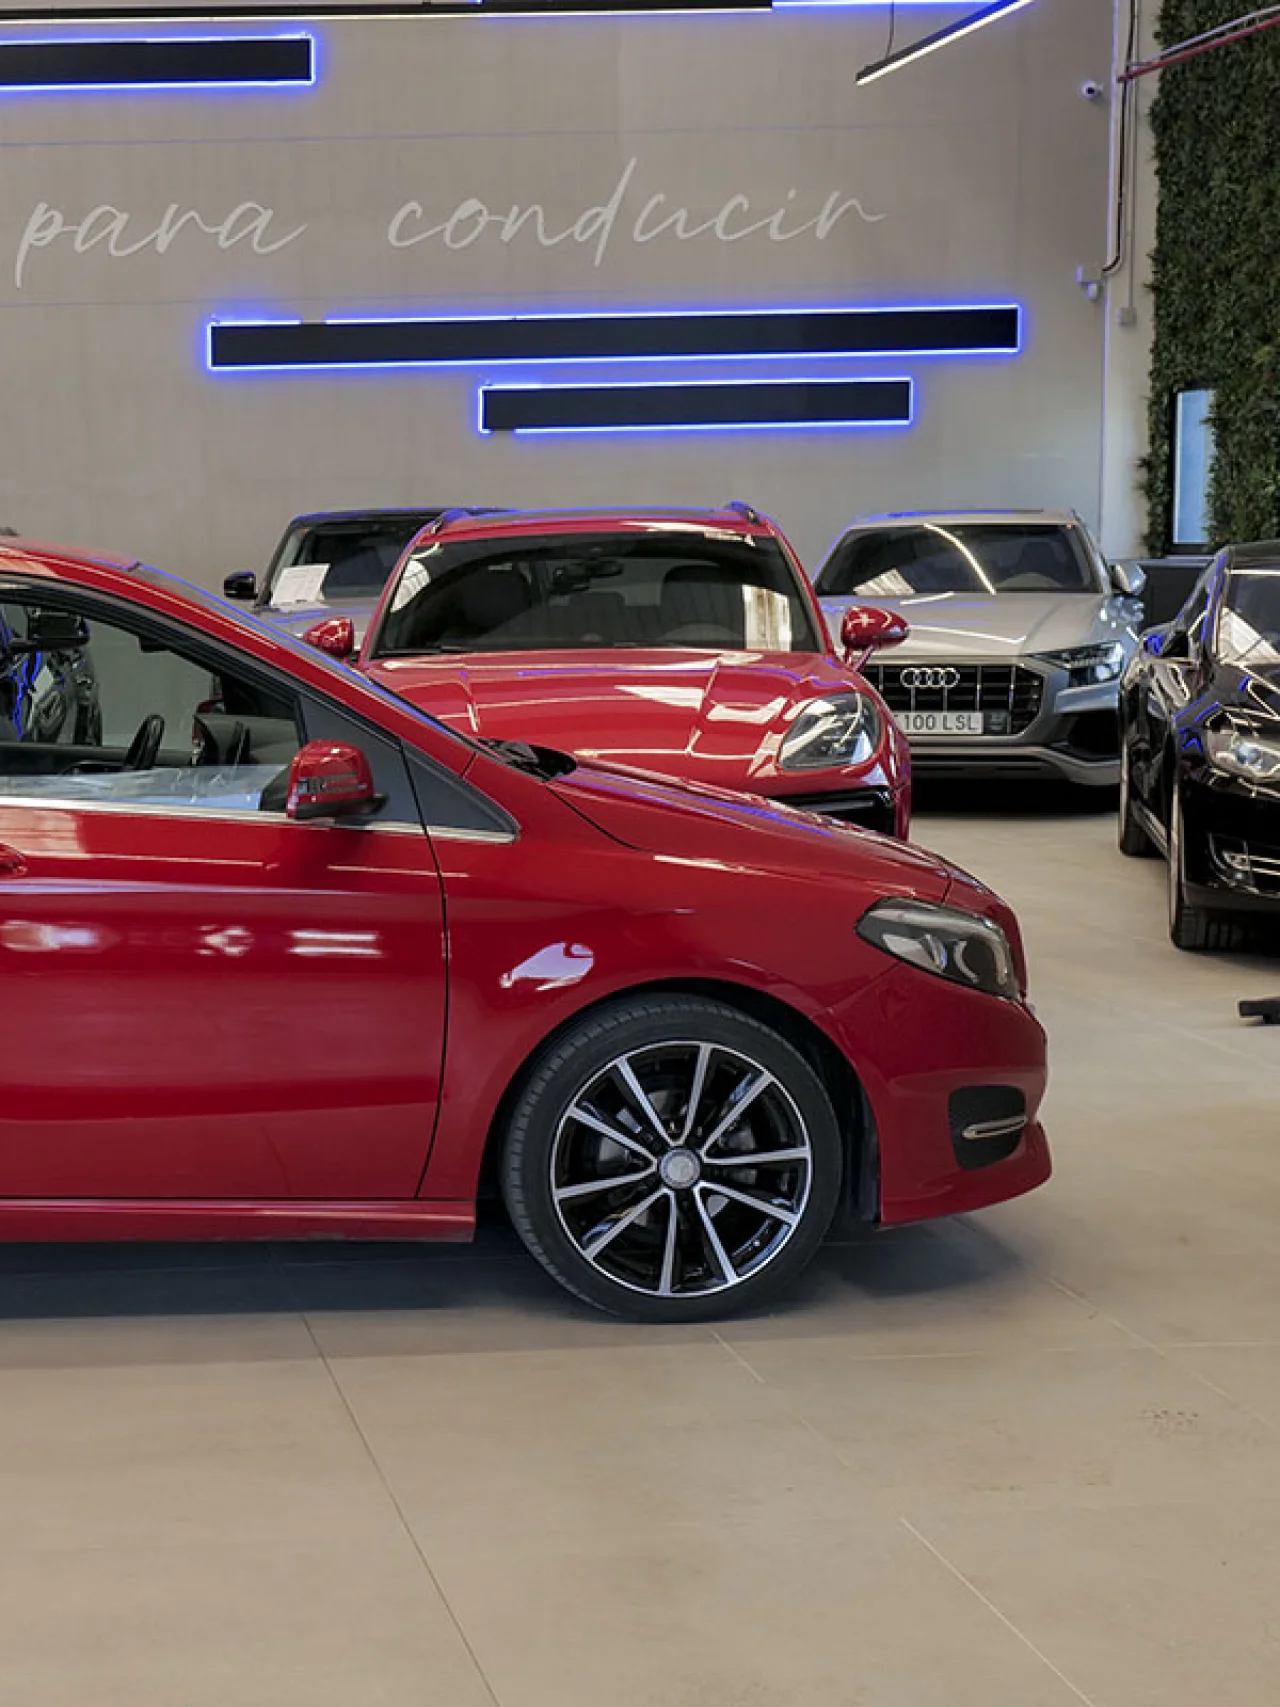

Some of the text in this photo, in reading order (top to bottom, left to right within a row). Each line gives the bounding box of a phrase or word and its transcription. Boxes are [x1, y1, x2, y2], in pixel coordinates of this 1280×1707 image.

[15, 201, 307, 288] para
[387, 157, 887, 267] conducir
[891, 714, 978, 730] 100 LSL
